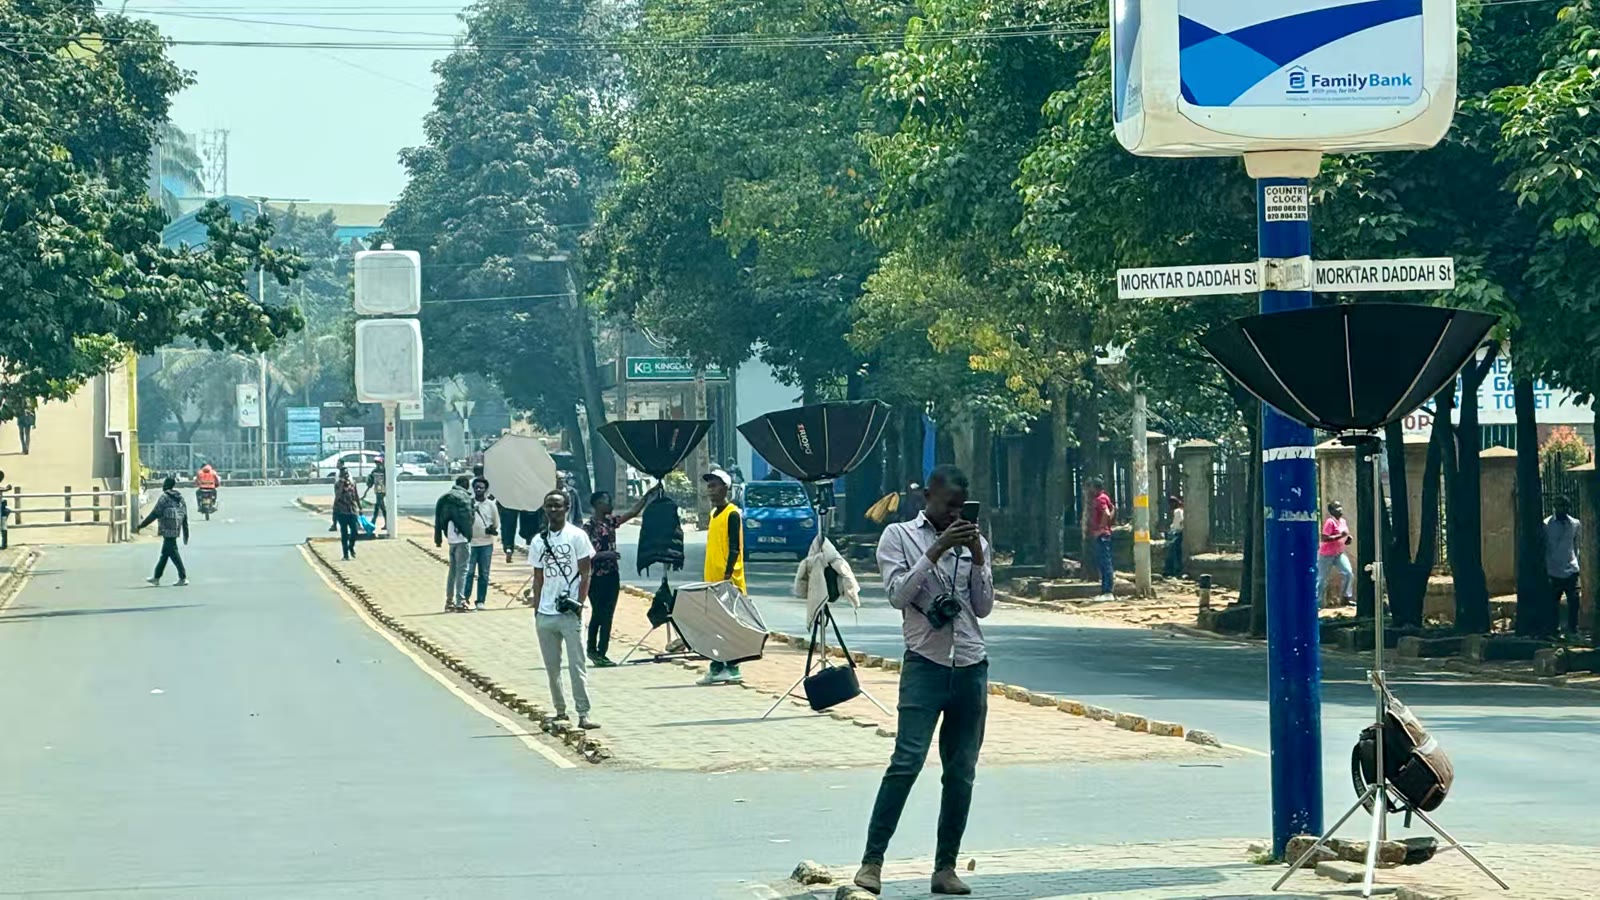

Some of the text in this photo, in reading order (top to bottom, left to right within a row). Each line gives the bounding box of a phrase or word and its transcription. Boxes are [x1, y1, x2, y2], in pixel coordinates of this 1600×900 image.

[1266, 187, 1307, 195] COUNTRY
[1272, 195, 1302, 203] CLOCK
[1121, 268, 1257, 291] MORKTAR DADDAH St
[1316, 266, 1378, 284] MORKTAR
[1382, 265, 1435, 282] DADDAH
[1439, 264, 1451, 281] St
[634, 362, 653, 374] KB
[1492, 393, 1552, 409] TOET
